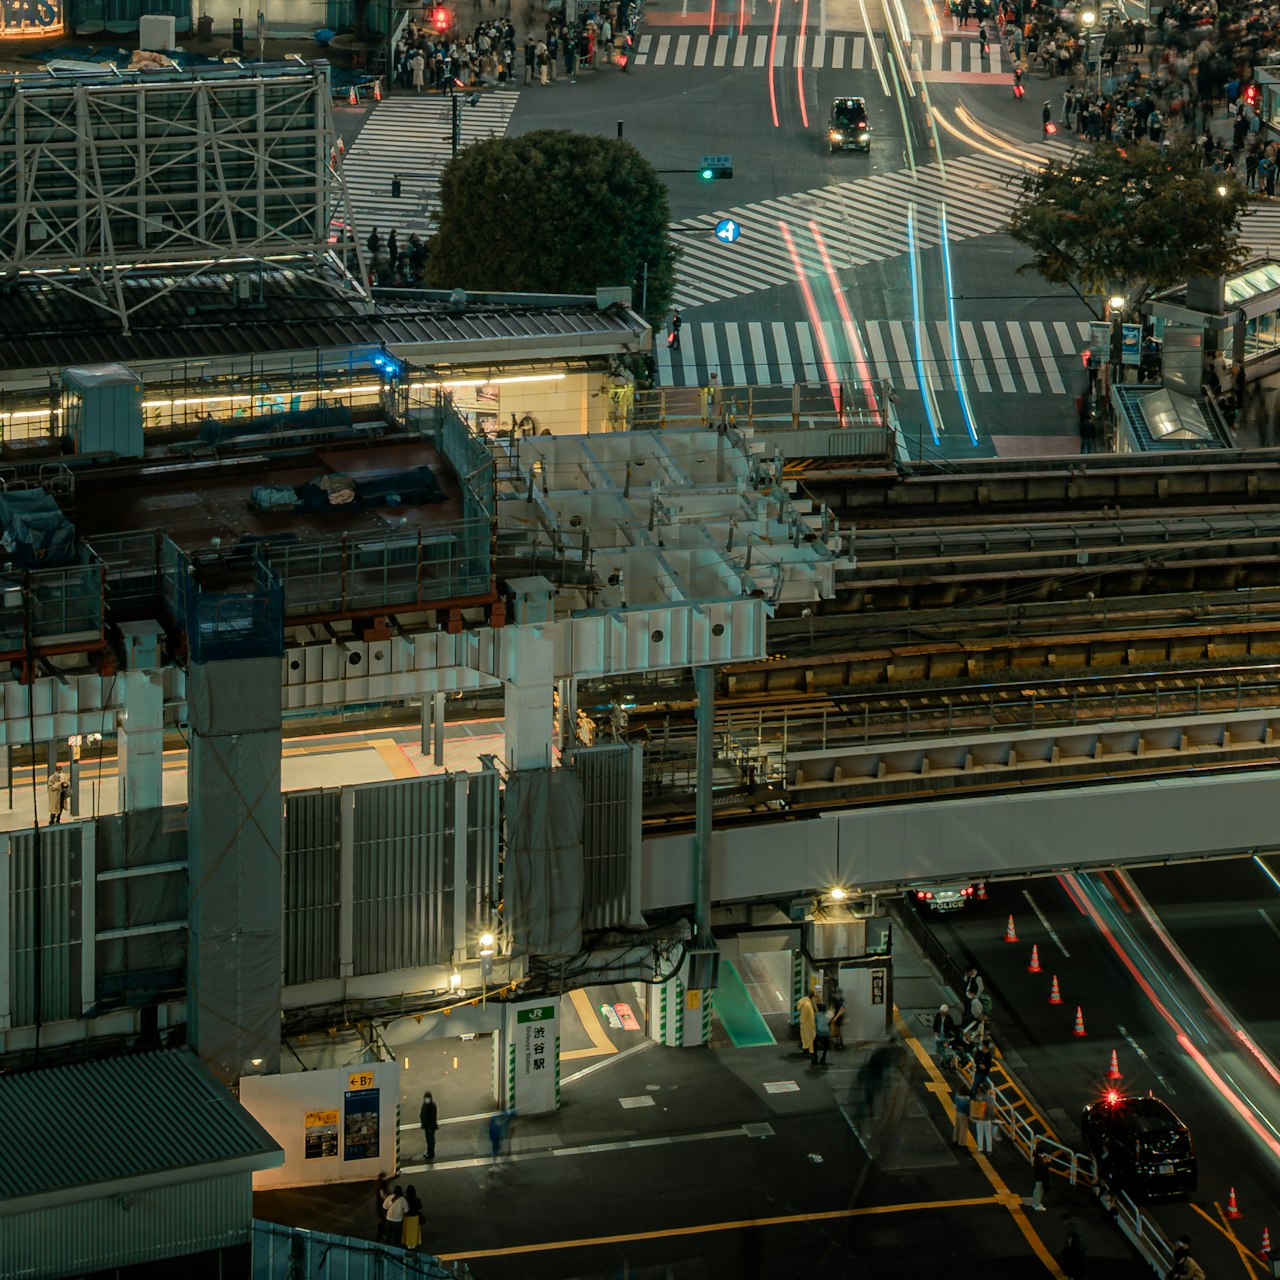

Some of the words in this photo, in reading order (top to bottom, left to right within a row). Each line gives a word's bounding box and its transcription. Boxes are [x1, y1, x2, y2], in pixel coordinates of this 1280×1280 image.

[930, 901, 965, 911] POLICE
[529, 1009, 544, 1019] JR
[533, 1027, 546, 1071] 渋谷駅
[360, 1076, 373, 1086] B7
